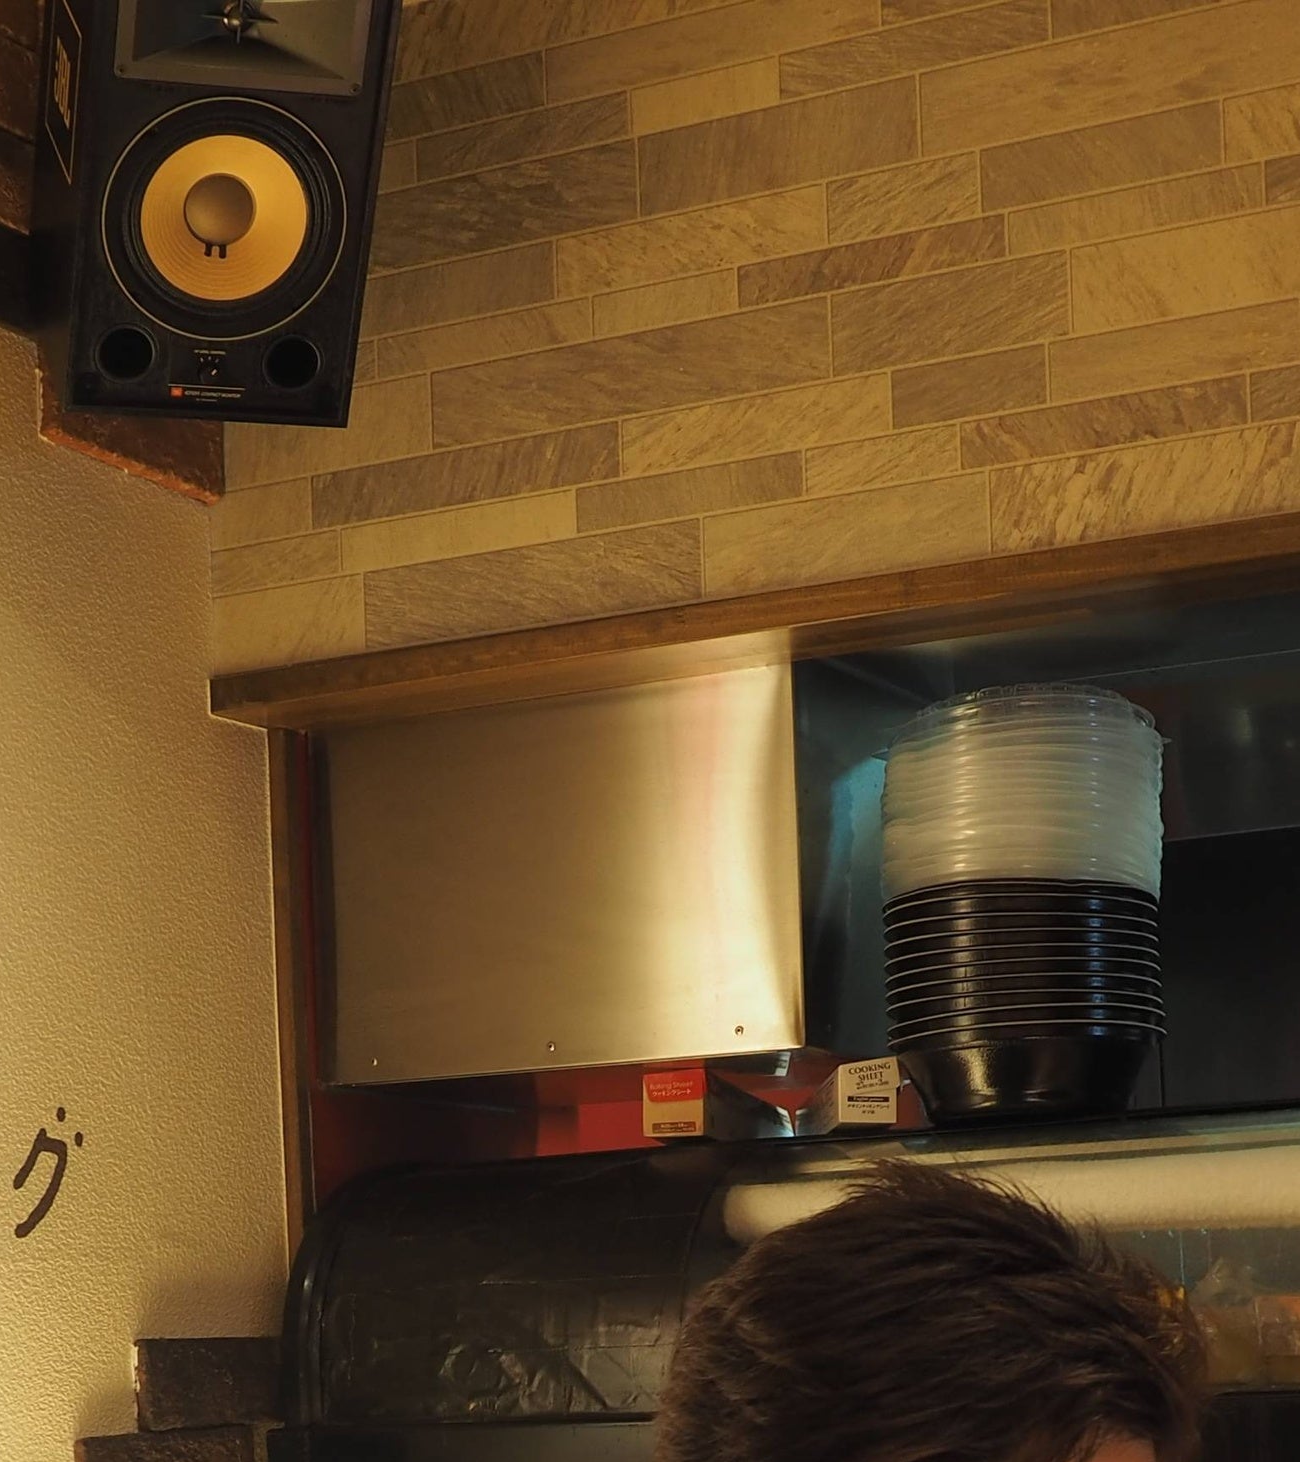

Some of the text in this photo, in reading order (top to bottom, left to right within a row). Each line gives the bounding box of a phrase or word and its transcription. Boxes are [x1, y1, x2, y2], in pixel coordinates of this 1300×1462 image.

[53, 35, 71, 130] JBL
[848, 1062, 891, 1075] COOKING
[858, 1071, 883, 1081] SHEET
